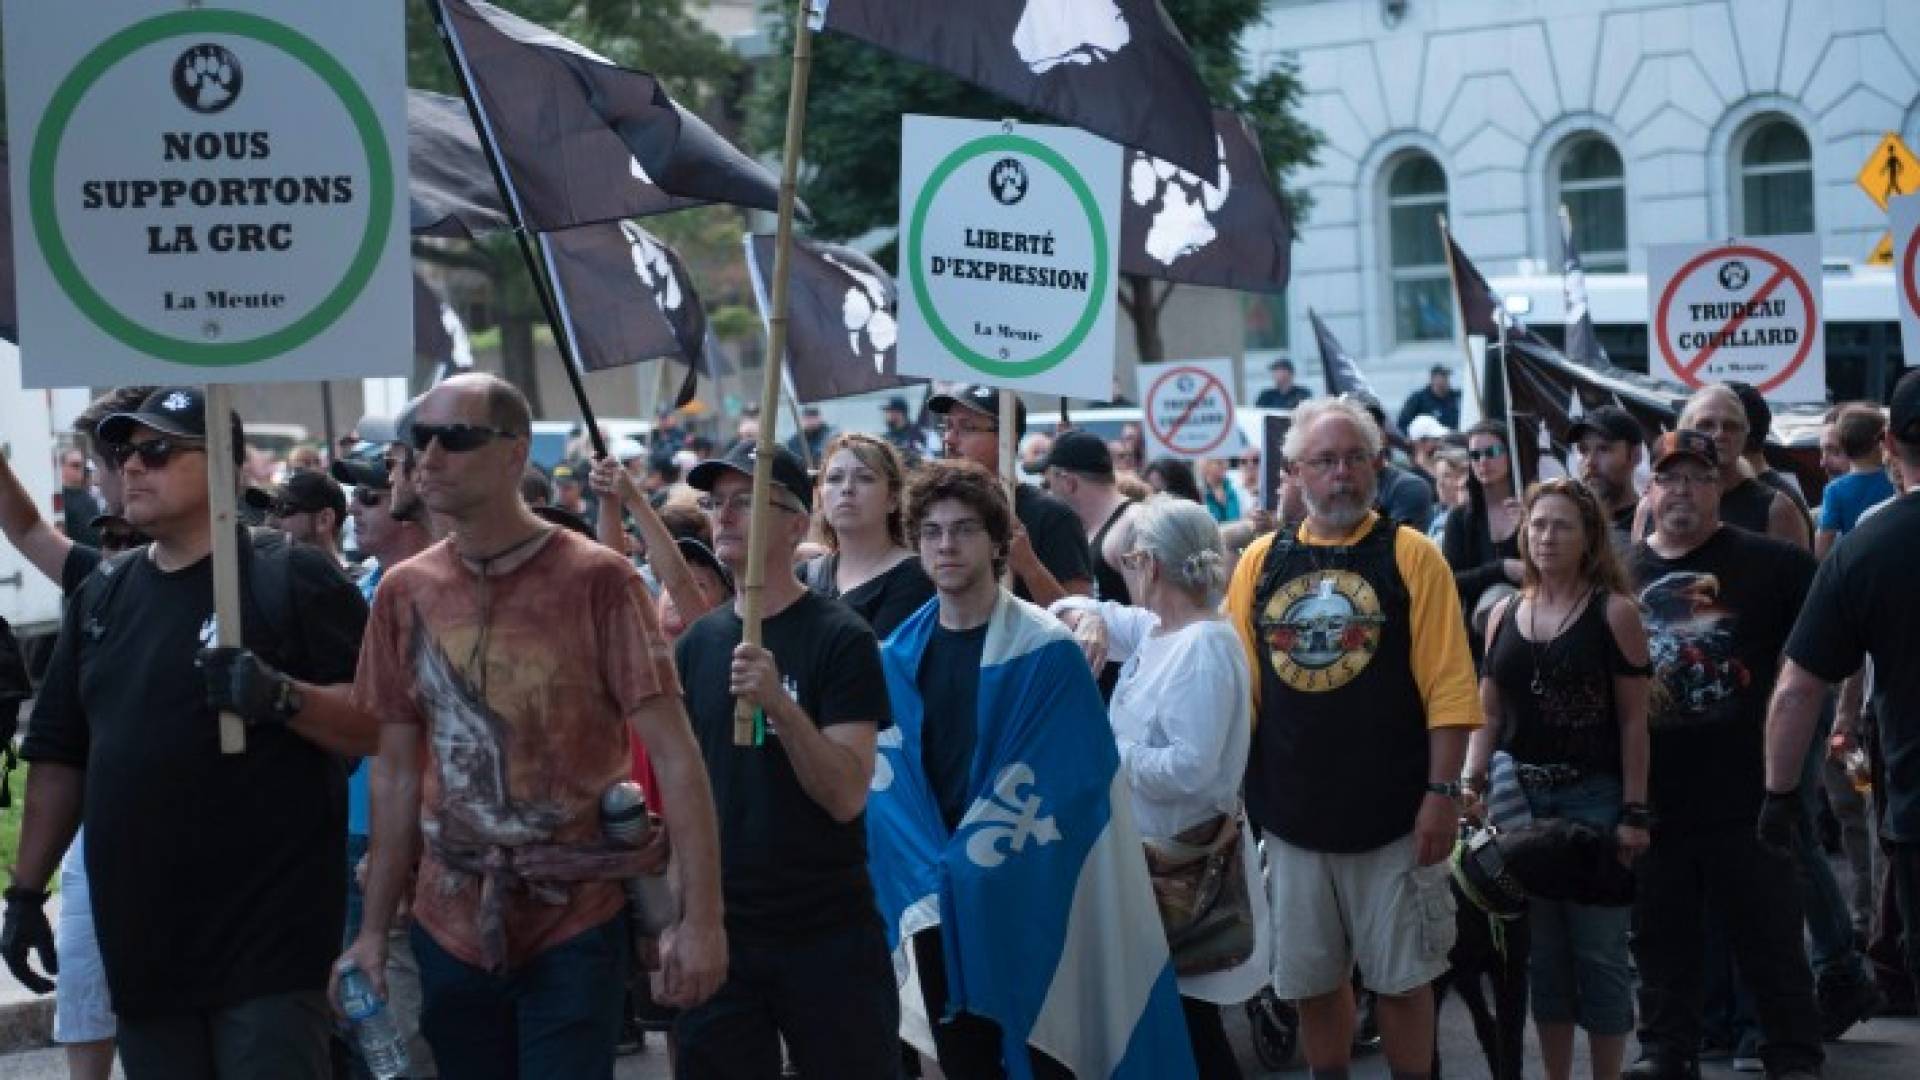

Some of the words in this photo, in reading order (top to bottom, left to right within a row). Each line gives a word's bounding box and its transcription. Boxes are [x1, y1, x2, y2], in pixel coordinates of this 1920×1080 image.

[163, 132, 271, 161] NOUS
[83, 176, 353, 209] SUPPORTONS
[147, 226, 198, 254] LA
[208, 223, 293, 252] GRC
[964, 229, 1055, 256] LIBERTÉ
[931, 256, 1089, 291] D'EXPRESSION
[164, 292, 196, 310] La
[206, 291, 285, 309] Meute
[1688, 298, 1786, 322] TRUDEAU
[974, 321, 992, 336] La
[1678, 326, 1799, 350] COUILLARD
